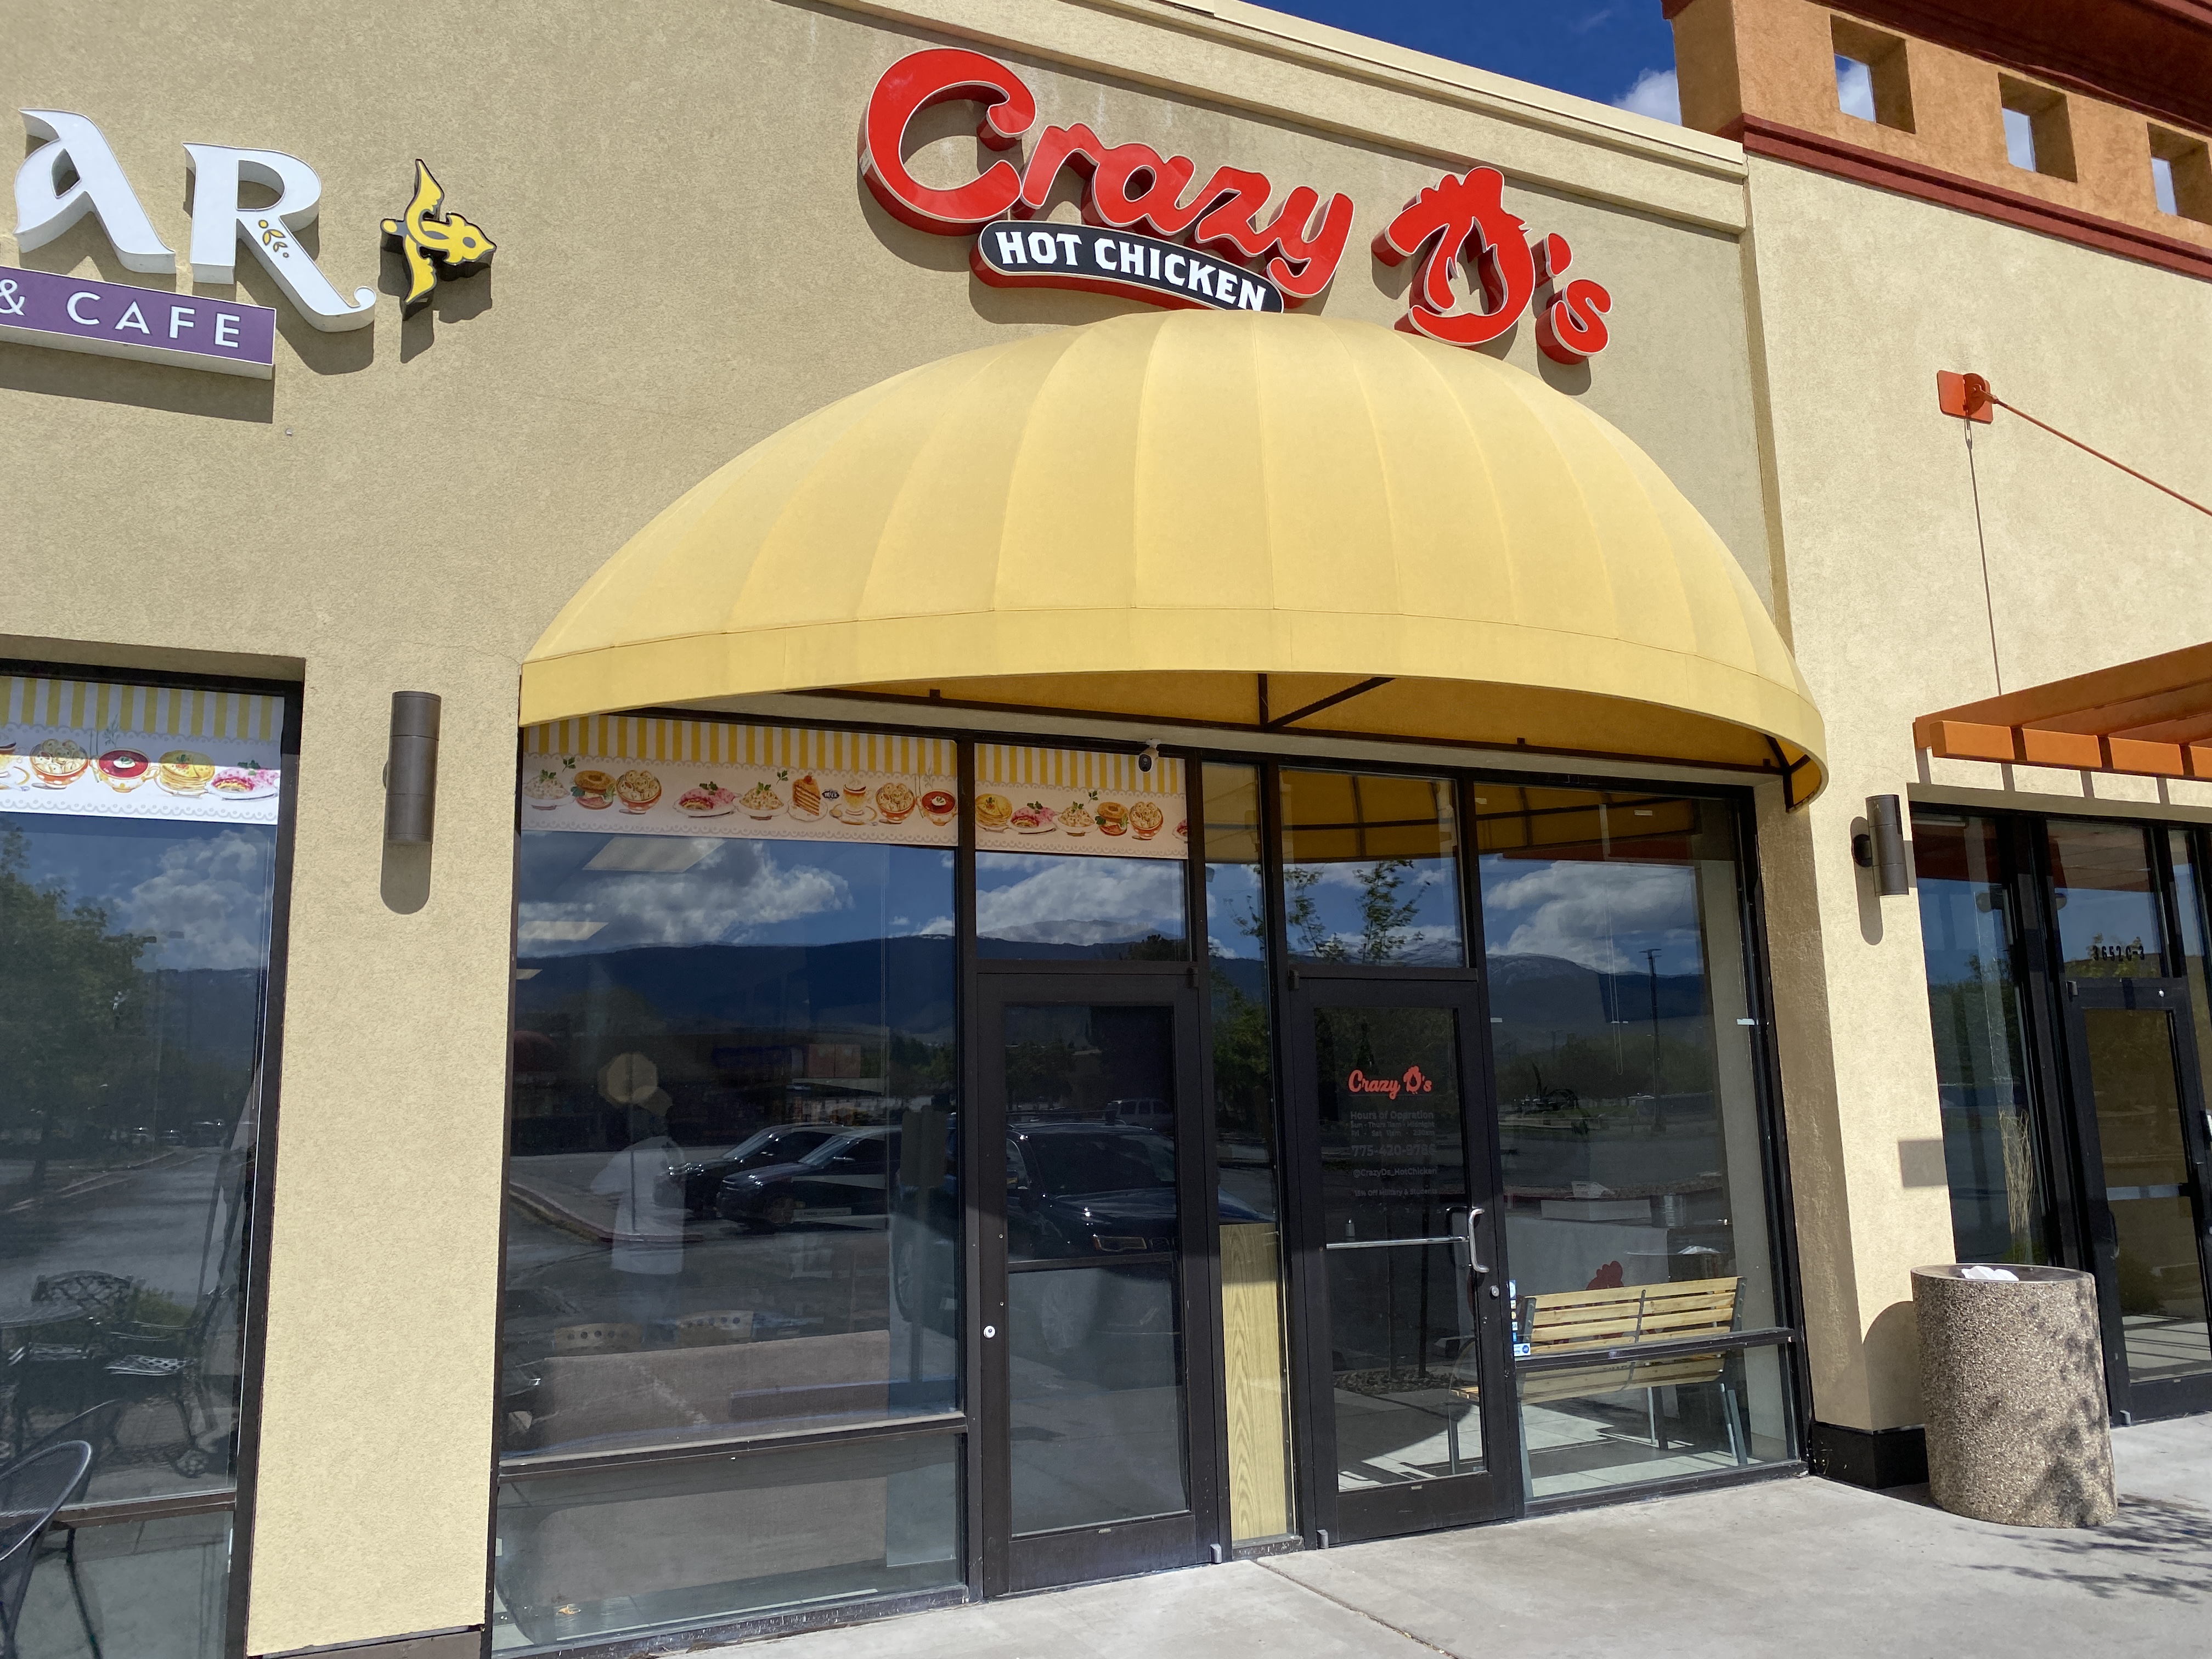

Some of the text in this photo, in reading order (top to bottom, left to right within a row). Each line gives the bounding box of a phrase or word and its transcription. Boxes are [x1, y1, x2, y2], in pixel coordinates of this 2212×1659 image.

[864, 47, 1355, 298] Crazy
[994, 230, 1267, 312] HOT CHICKEN
[0, 278, 241, 349] & CAFE
[1348, 1069, 1401, 1100] Crazy
[1350, 1109, 1435, 1121] Hours of Operation
[1407, 1120, 1435, 1129] Midnight
[1379, 1188, 1403, 1197] Military
[1409, 1188, 1438, 1197] Students
